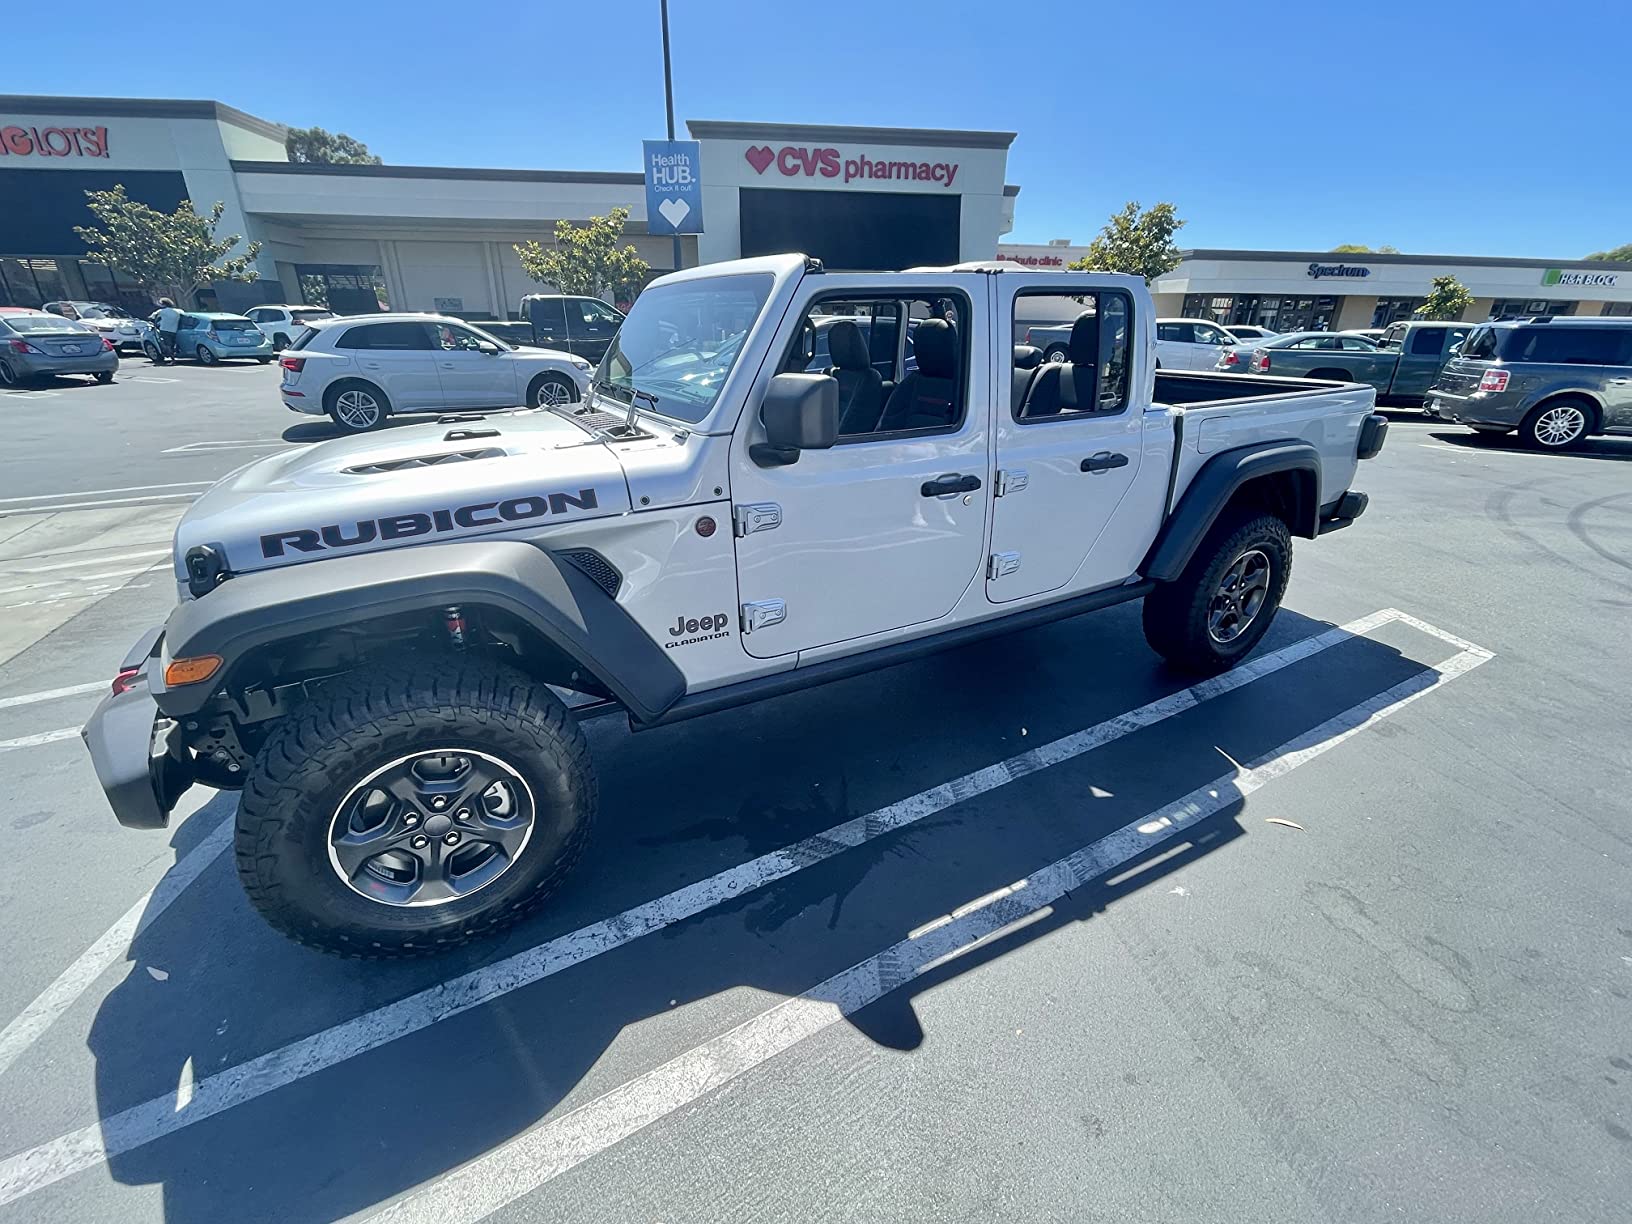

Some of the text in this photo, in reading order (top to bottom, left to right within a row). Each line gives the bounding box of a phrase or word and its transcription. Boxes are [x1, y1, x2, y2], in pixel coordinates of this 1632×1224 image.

[652, 153, 690, 166] Health
[777, 146, 959, 188] CVS pharmacy
[1039, 256, 1062, 266] clinic
[1307, 262, 1367, 279] Spectrum
[1559, 274, 1617, 286] H&R BLOCK
[259, 488, 599, 559] RUBICON
[669, 613, 729, 636] Jeep
[664, 631, 730, 649] GLADIATOR
